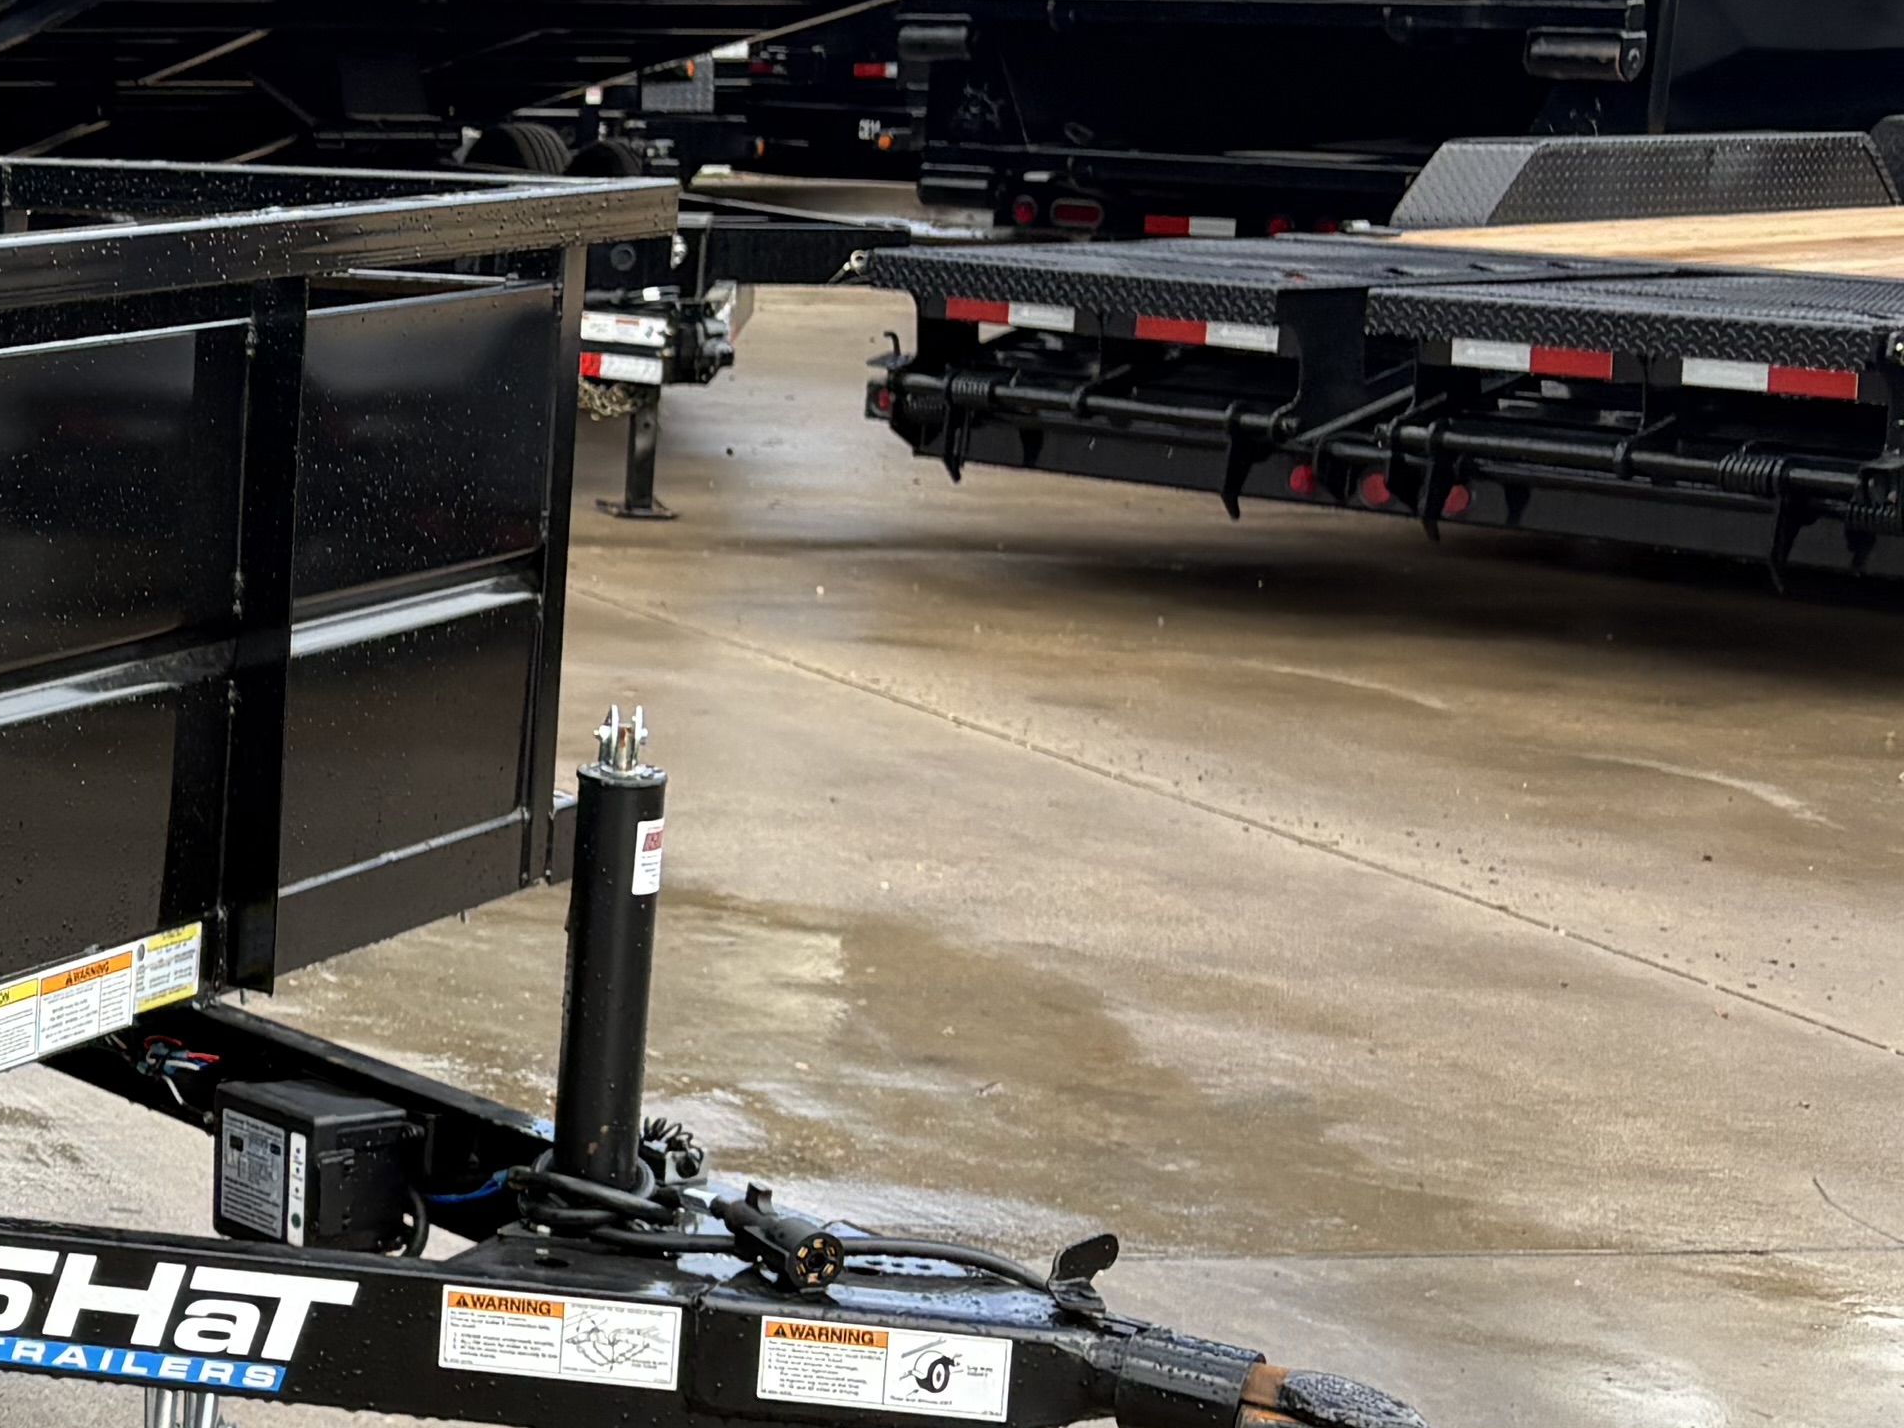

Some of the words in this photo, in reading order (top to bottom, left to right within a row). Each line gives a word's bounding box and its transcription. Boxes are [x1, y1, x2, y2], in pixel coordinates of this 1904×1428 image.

[73, 961, 110, 983] WARNING
[470, 1294, 552, 1316] WARNING
[791, 1324, 875, 1345] WARNING
